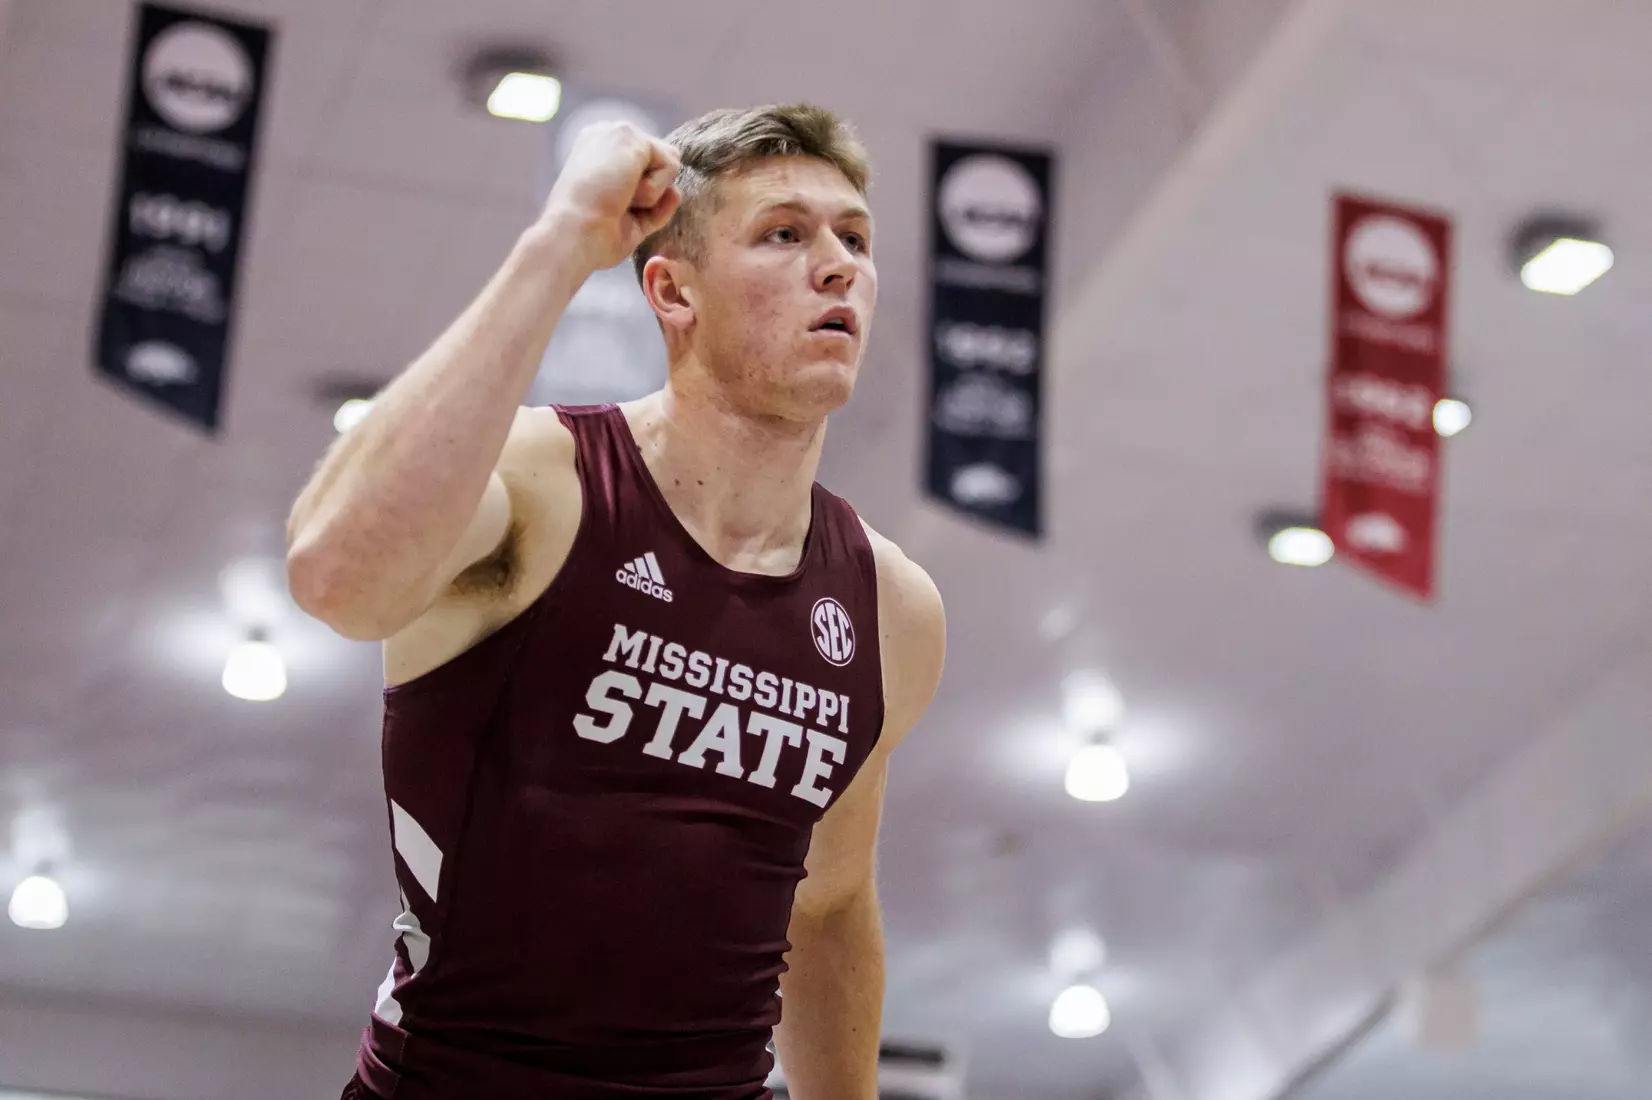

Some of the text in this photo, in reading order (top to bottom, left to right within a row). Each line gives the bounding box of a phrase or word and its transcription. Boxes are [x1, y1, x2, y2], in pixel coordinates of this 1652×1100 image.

[615, 568, 673, 603] adidas
[815, 601, 853, 662] SEC
[602, 623, 850, 734] MISSISSIPPI
[572, 670, 848, 808] STATE
